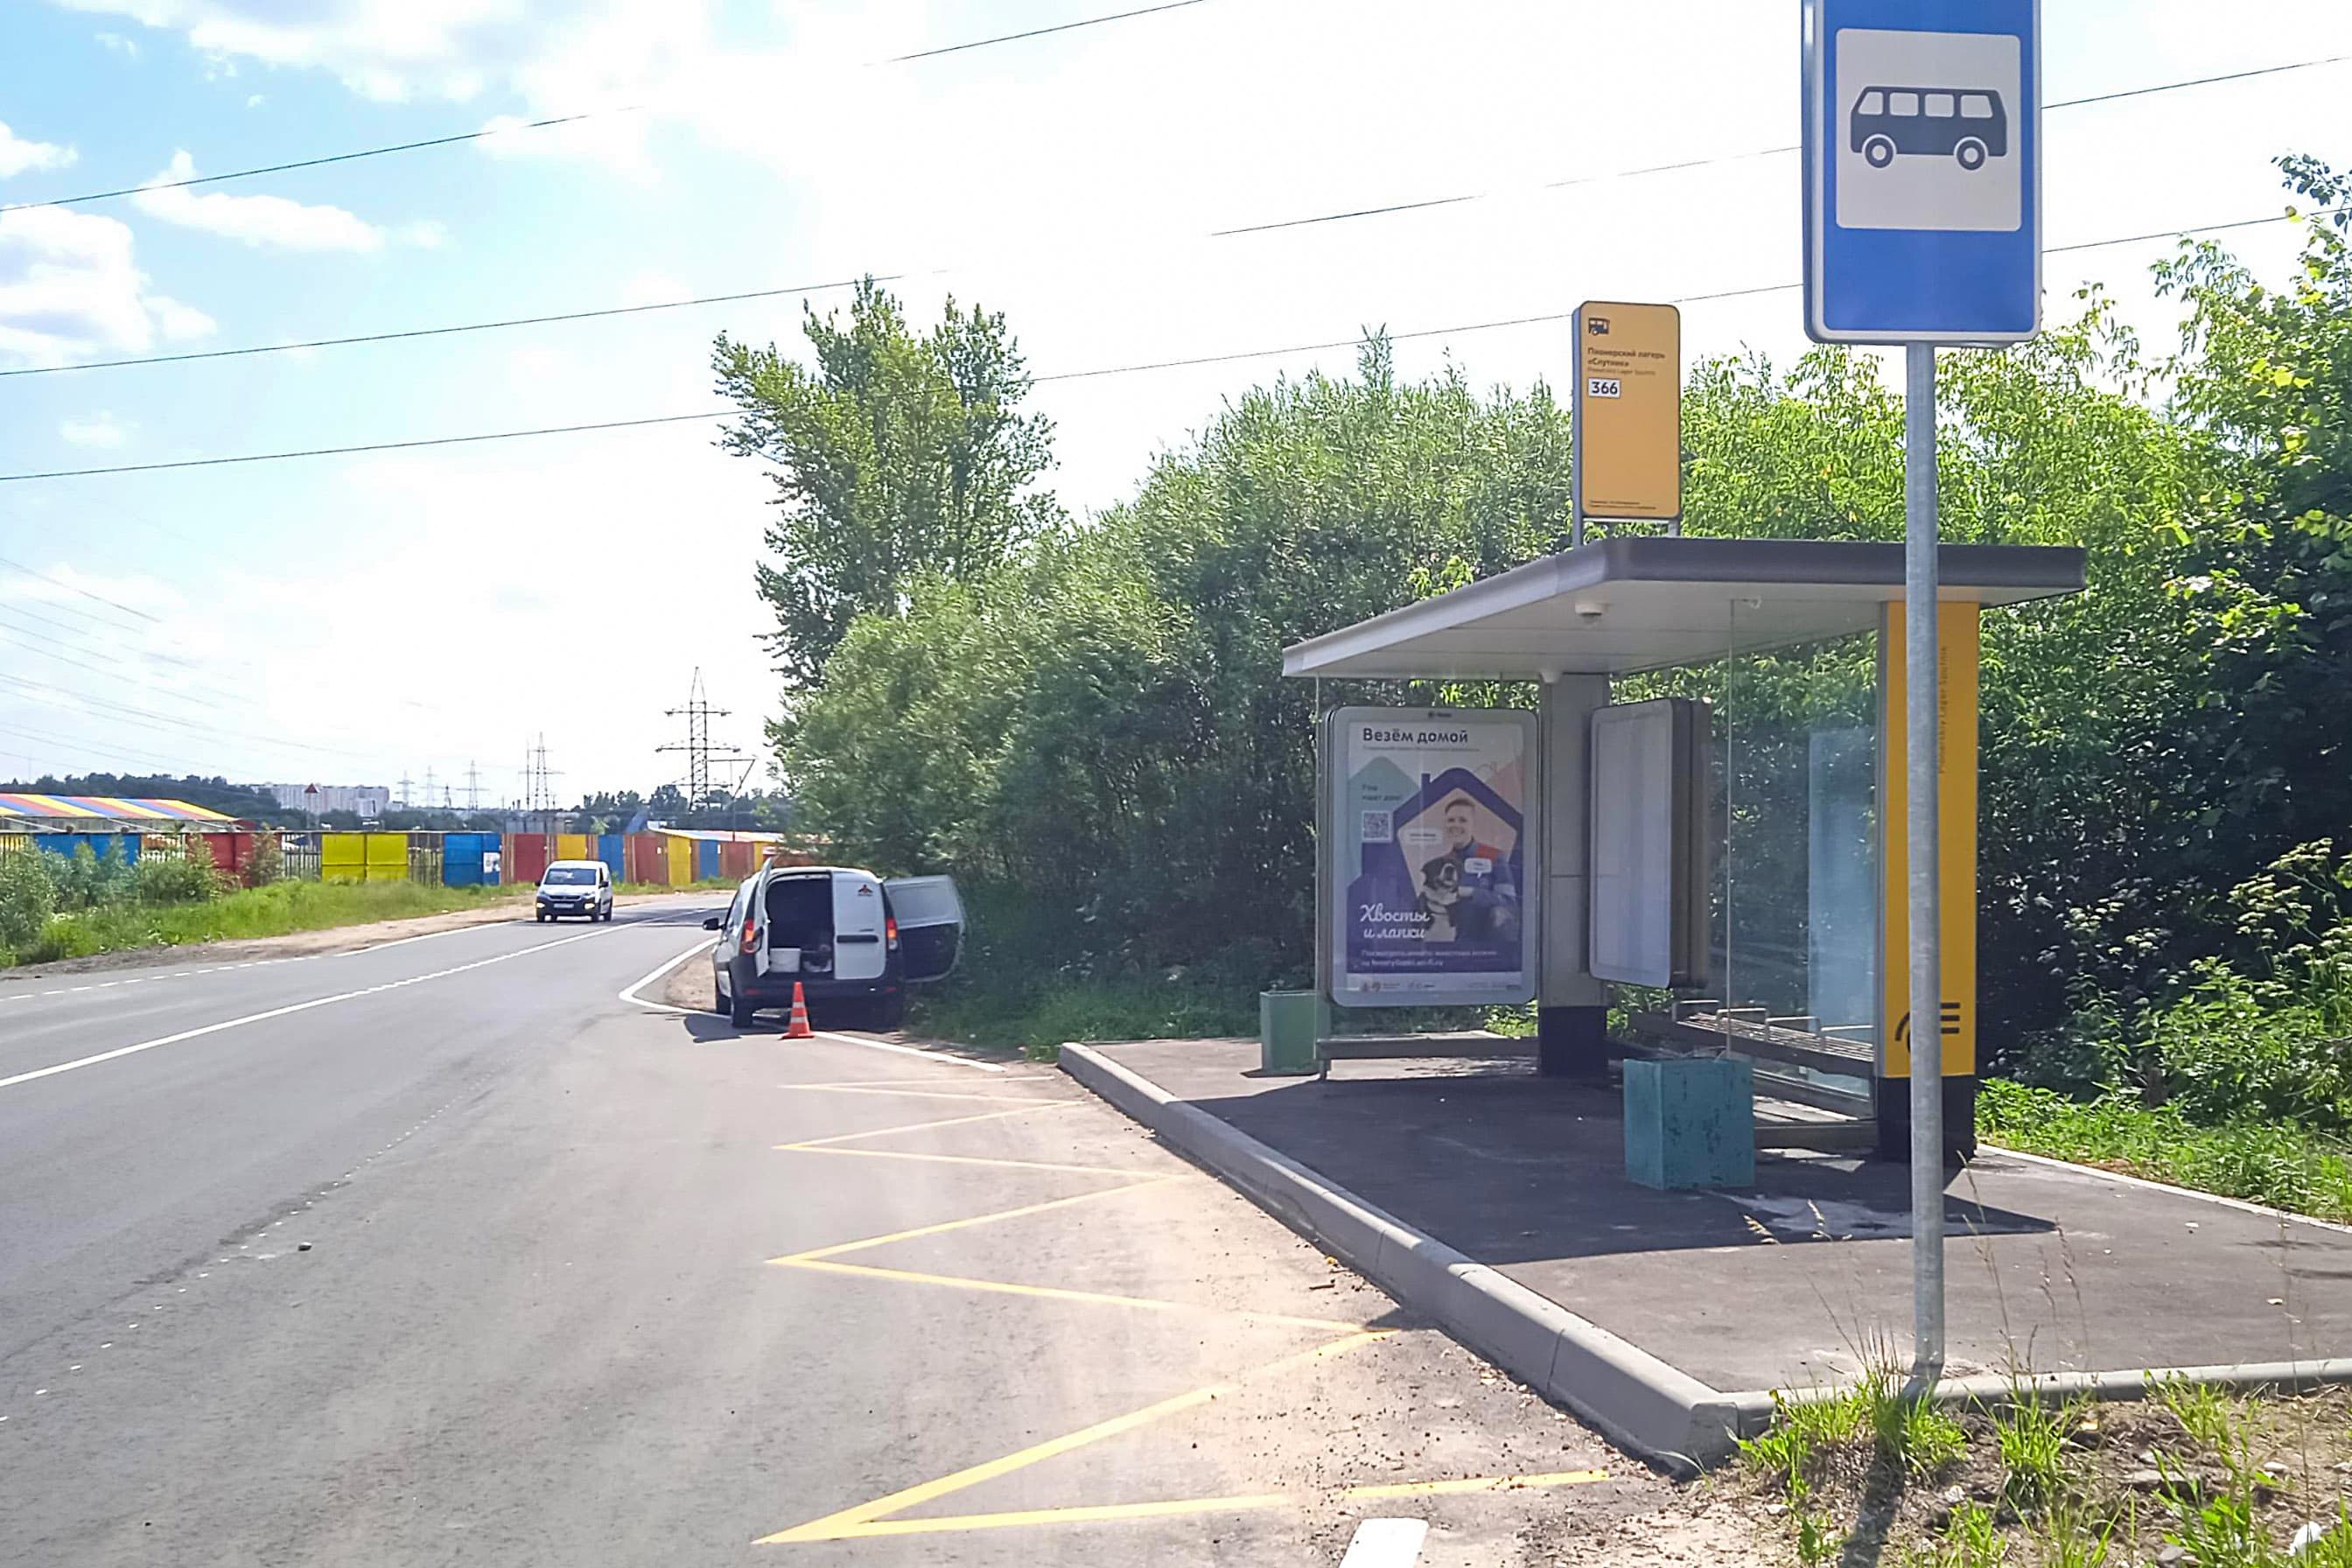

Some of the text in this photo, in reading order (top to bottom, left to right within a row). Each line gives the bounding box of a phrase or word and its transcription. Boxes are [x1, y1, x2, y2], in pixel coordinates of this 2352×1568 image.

[1591, 381, 1618, 395] 366
[1362, 727, 1468, 744] Везём домой
[1359, 902, 1431, 922] Хвосты
[1363, 926, 1425, 939] и лапки
